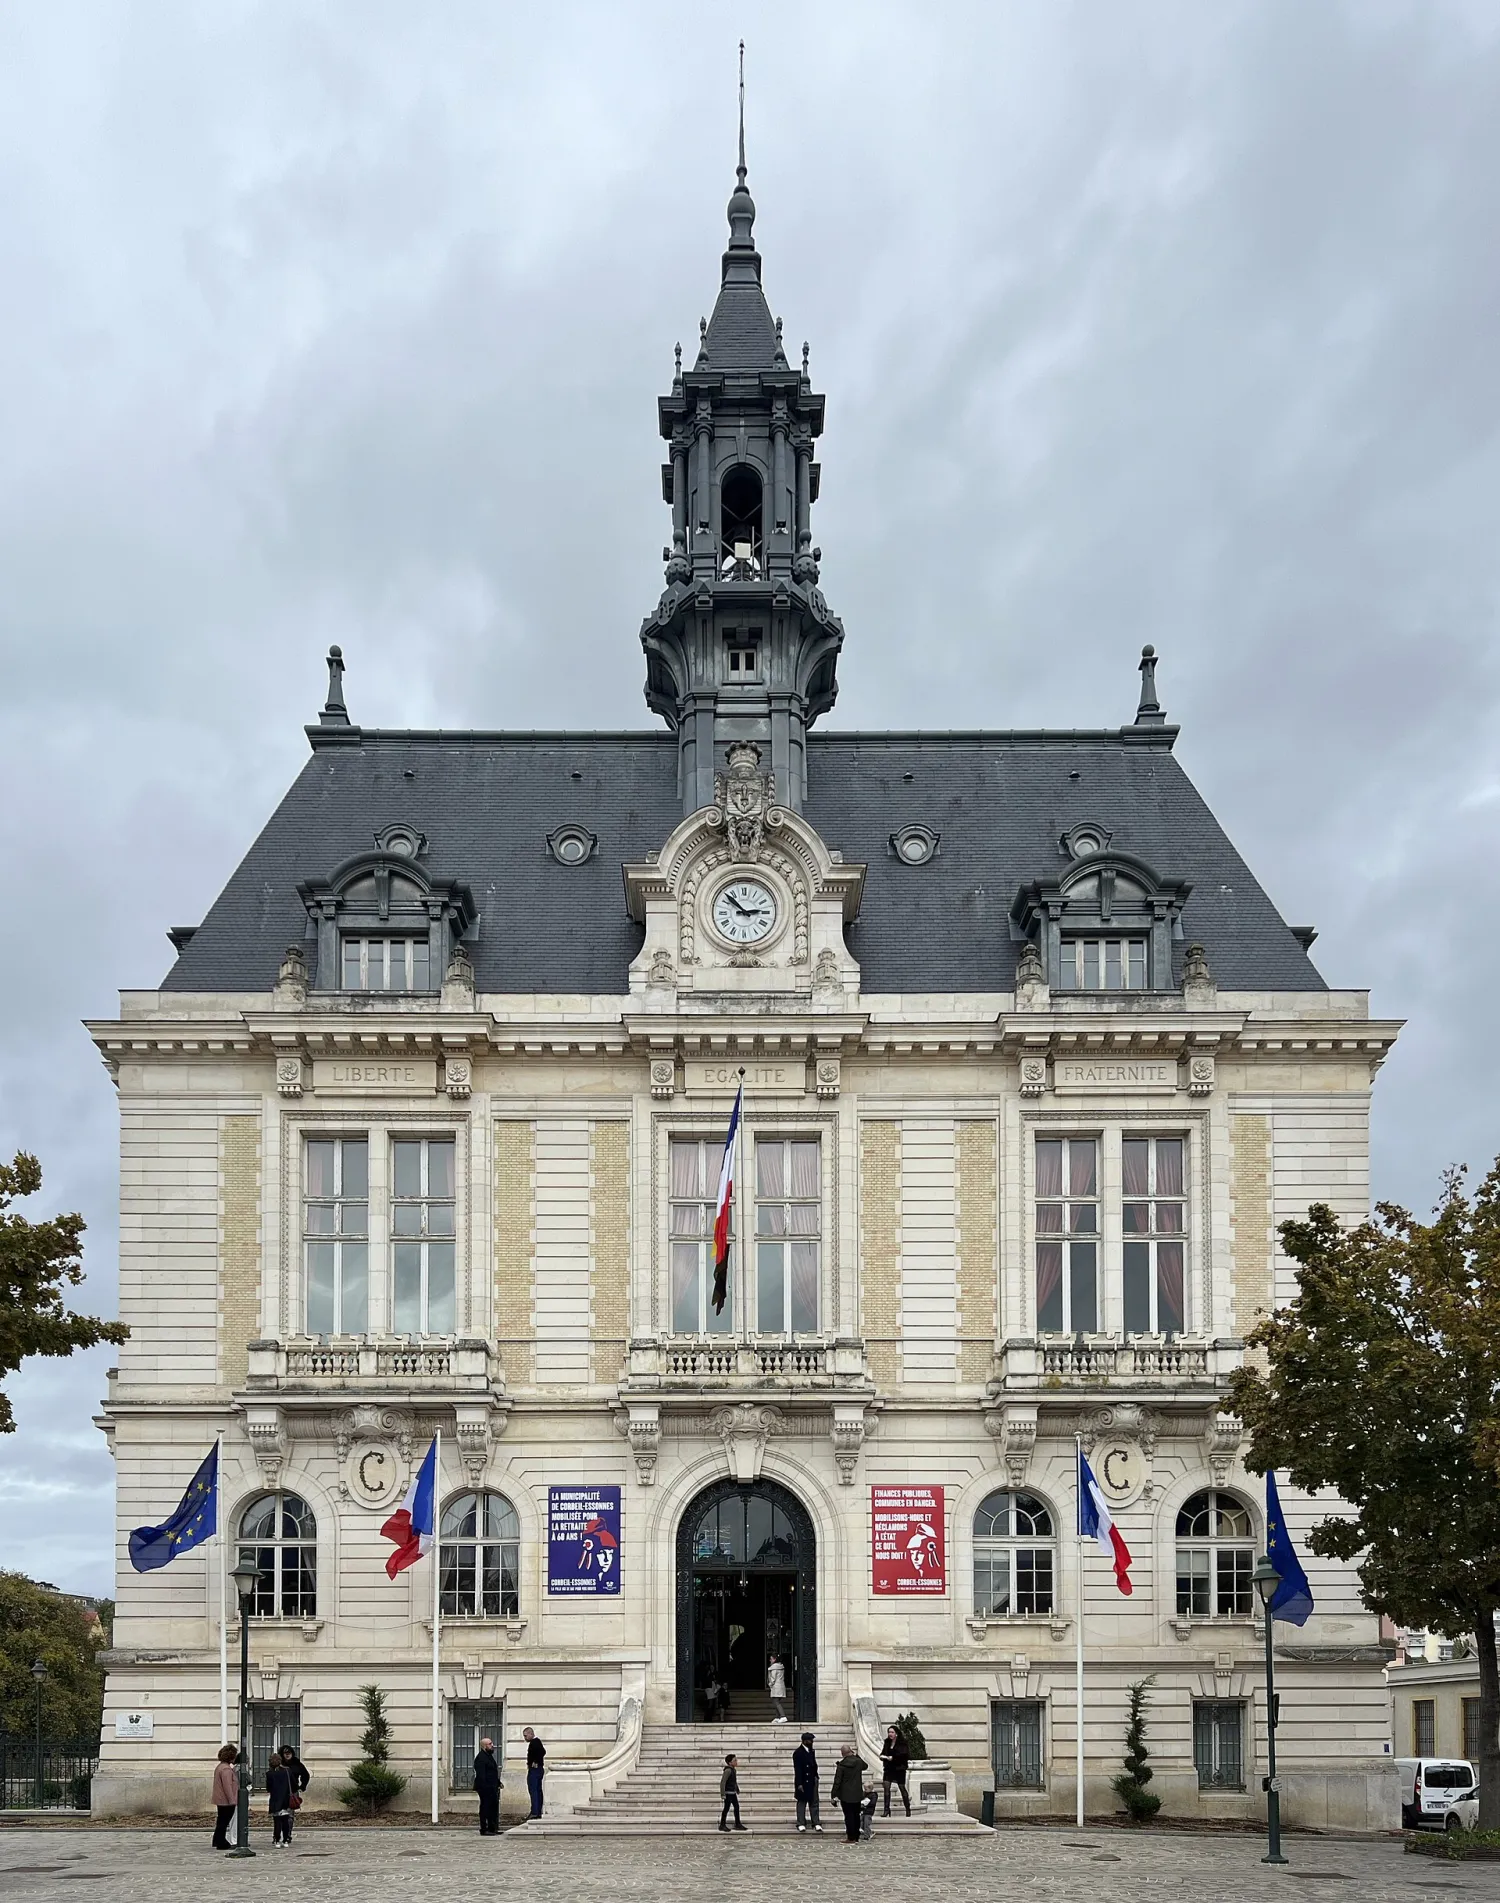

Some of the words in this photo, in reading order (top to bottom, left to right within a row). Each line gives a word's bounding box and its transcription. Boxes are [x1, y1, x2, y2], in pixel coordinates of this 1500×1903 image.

[332, 1066, 416, 1082] LIBERTE
[1064, 1066, 1168, 1081] FRATERNITE
[552, 1492, 559, 1500] LA
[560, 1491, 601, 1501] MUNICIPALITÉ
[875, 1490, 901, 1498] FINANCES
[552, 1502, 559, 1510] DE
[560, 1502, 614, 1511] CORBEIL-ESSONNES
[875, 1499, 905, 1507] COMMUNES
[906, 1499, 913, 1507] EN
[552, 1511, 582, 1521] MOBILISÉE
[582, 1512, 598, 1521] POUR
[875, 1514, 924, 1522] MOBILISONS-NOUS
[925, 1514, 932, 1522] ET
[552, 1522, 559, 1531] LA
[560, 1522, 588, 1531] RETRAITE
[875, 1522, 908, 1531] RÉCLAMONS
[566, 1532, 578, 1541] ANS
[875, 1542, 882, 1550] CE
[875, 1551, 890, 1560] NOUS
[890, 1551, 904, 1560] DOIT
